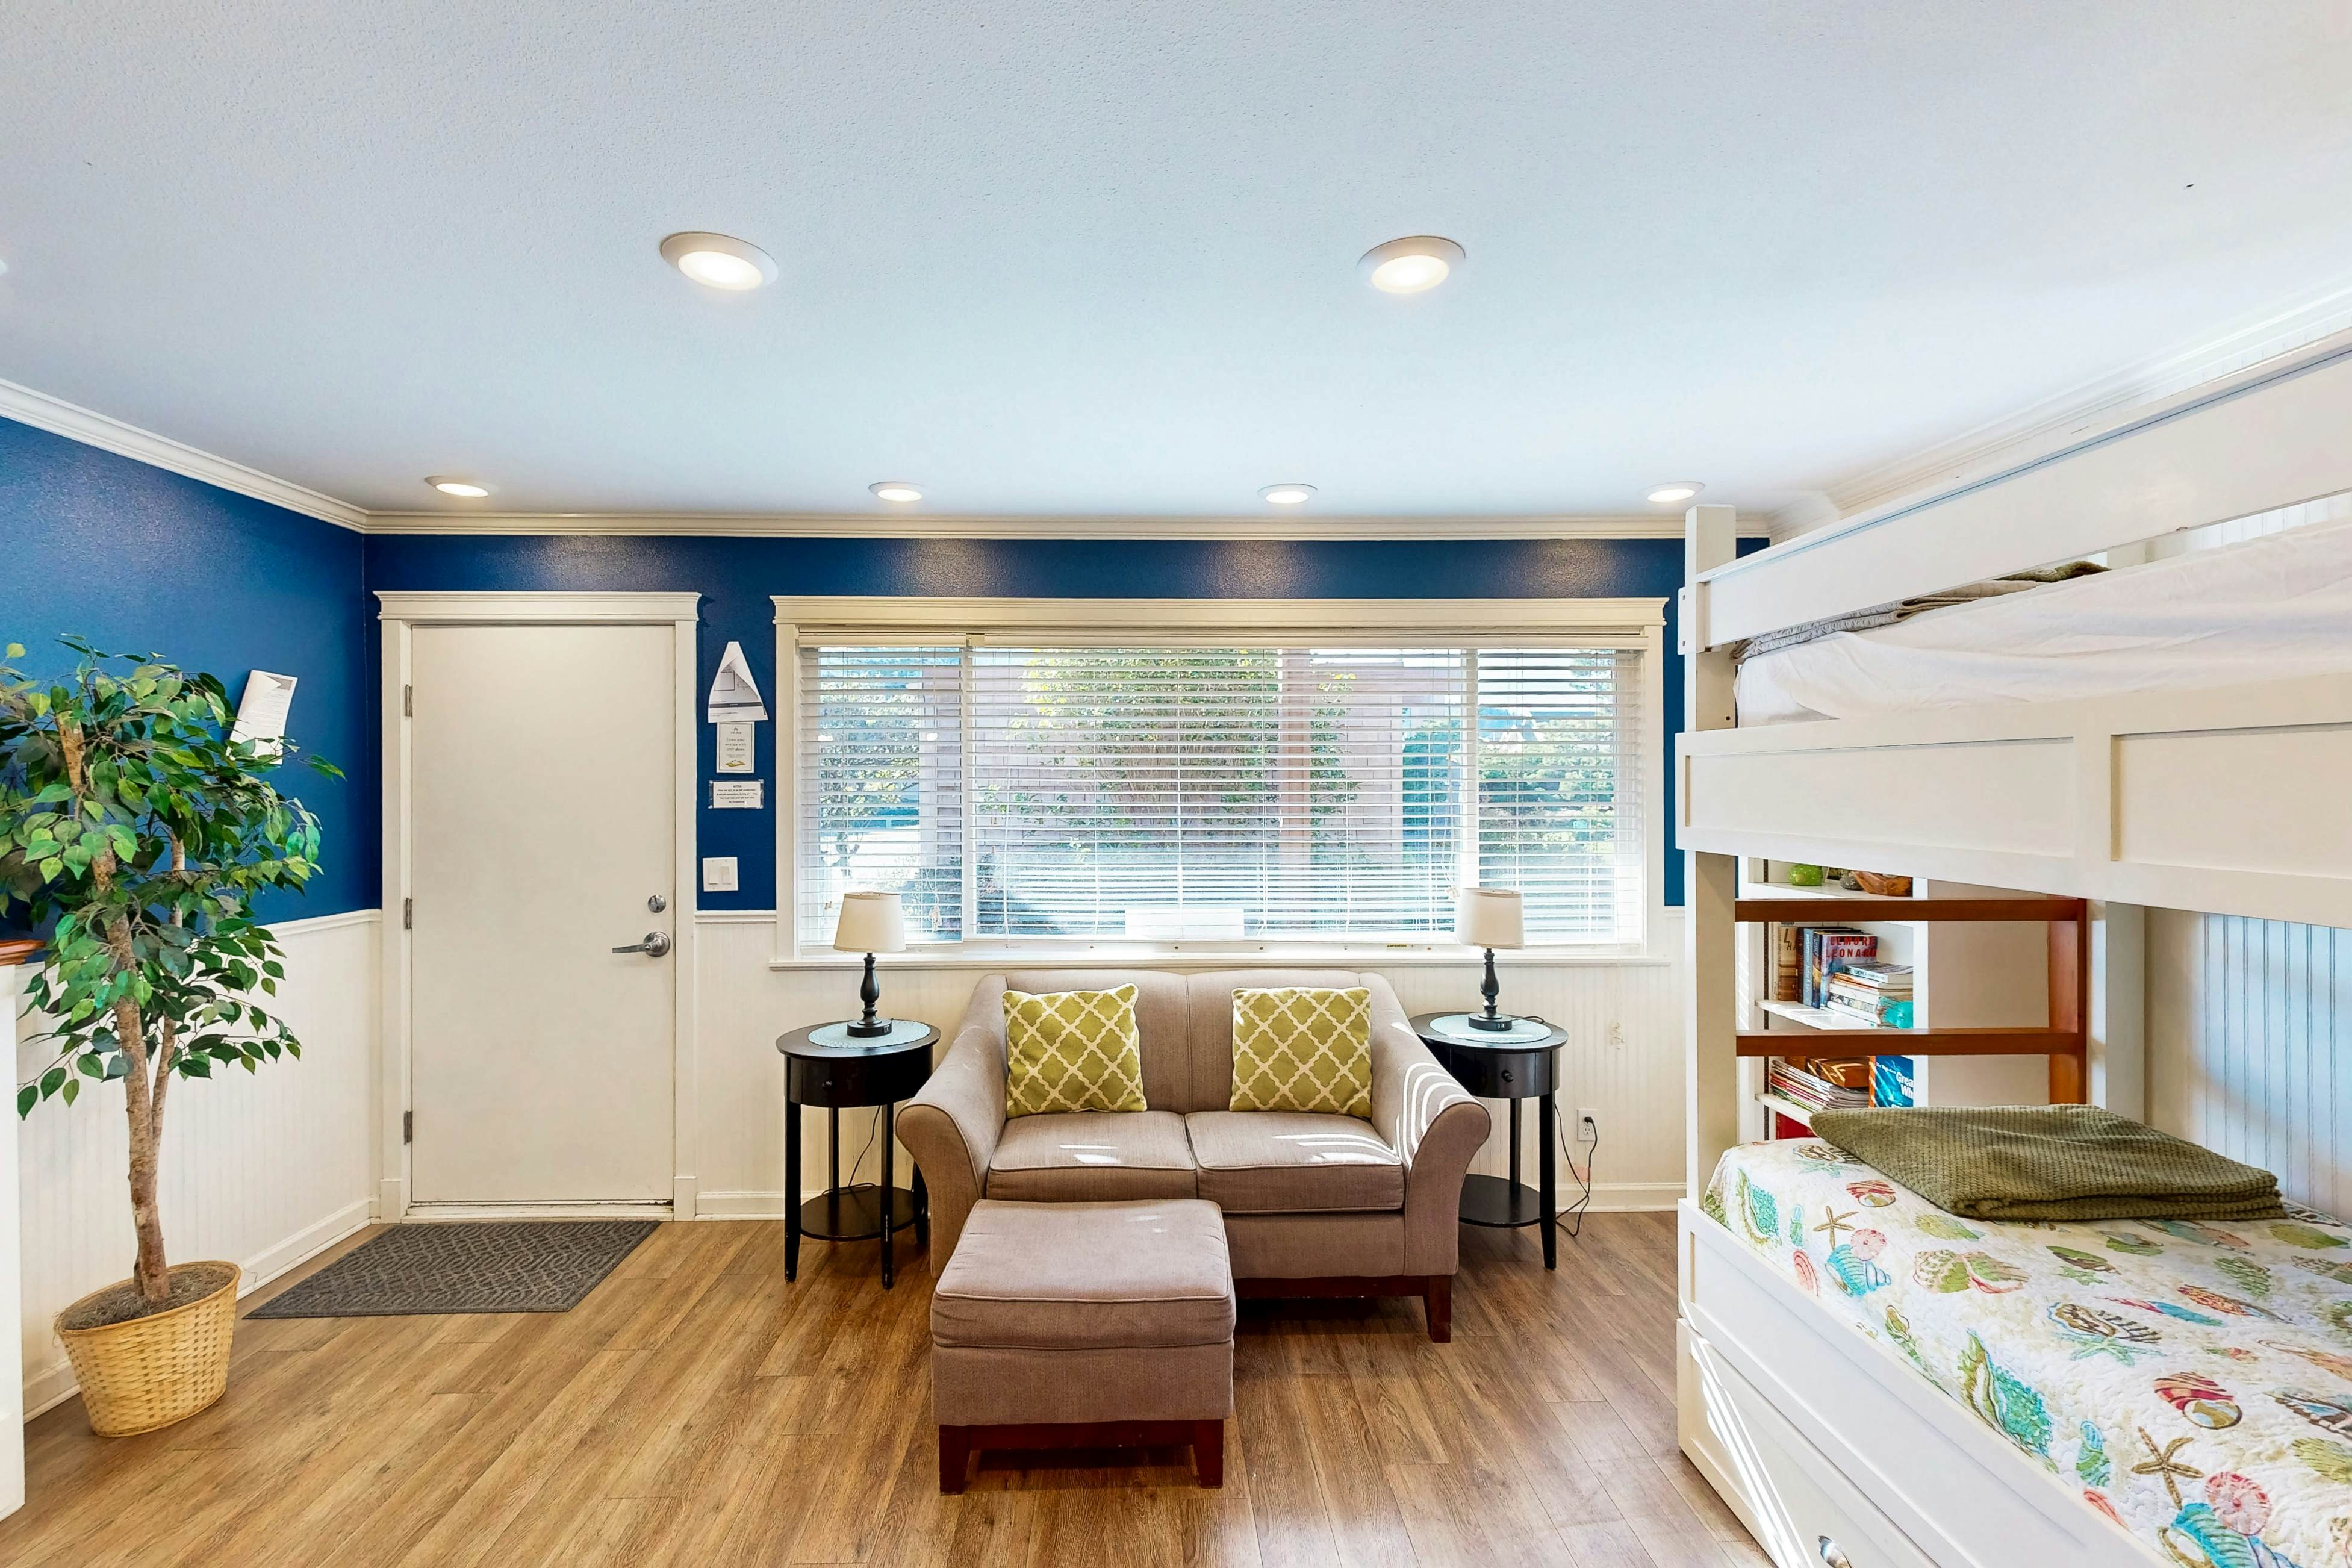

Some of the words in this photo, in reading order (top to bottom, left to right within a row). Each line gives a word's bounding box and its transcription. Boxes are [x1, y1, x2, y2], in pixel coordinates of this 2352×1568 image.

[1830, 936, 1877, 946] ELMORE
[1826, 948, 1877, 958] LEONARD
[1896, 1072, 1914, 1089] Grea
